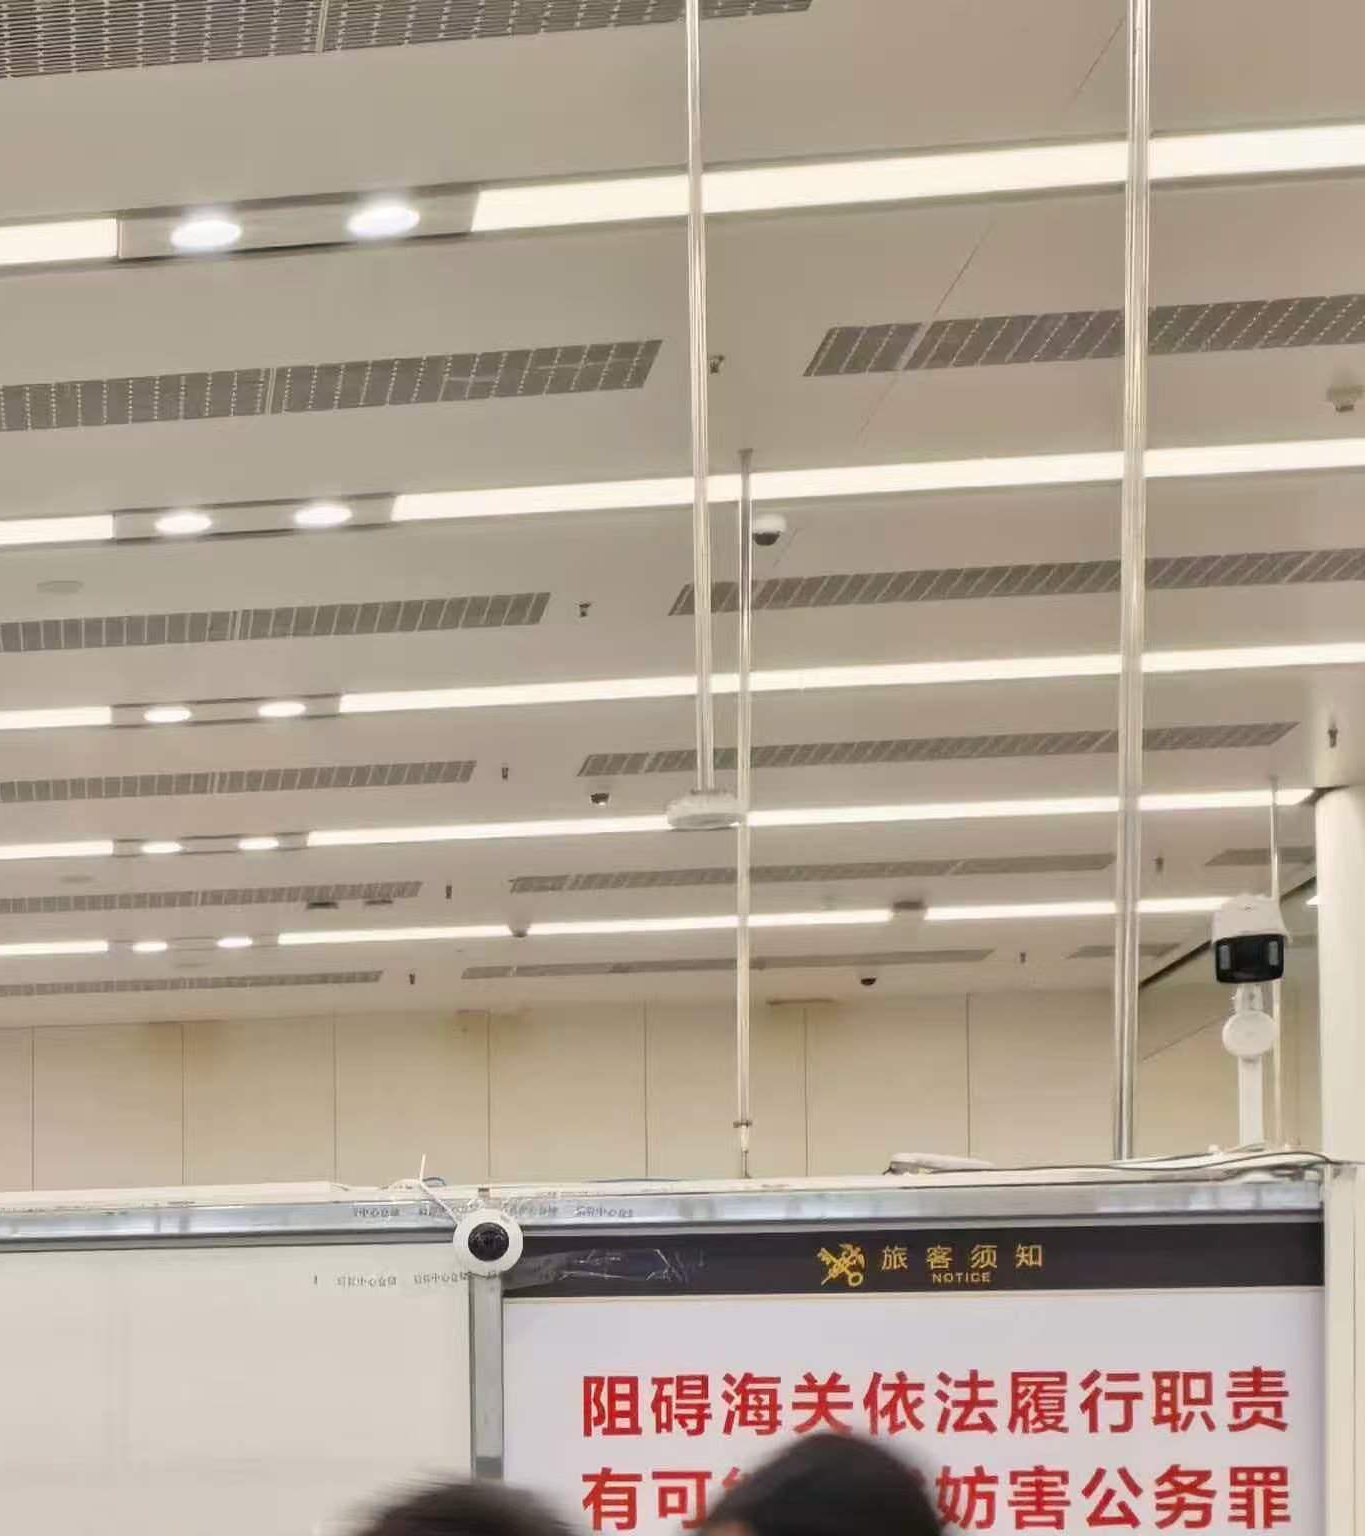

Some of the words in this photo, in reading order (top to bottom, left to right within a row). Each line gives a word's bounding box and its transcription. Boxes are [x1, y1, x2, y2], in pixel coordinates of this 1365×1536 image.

[881, 1243, 1042, 1270] 旅客须知
[932, 1271, 990, 1284] NOTICE
[582, 1366, 1290, 1438] 阻碍海关依法履行职责
[581, 1464, 1291, 1532] 有可妨害公务罪
